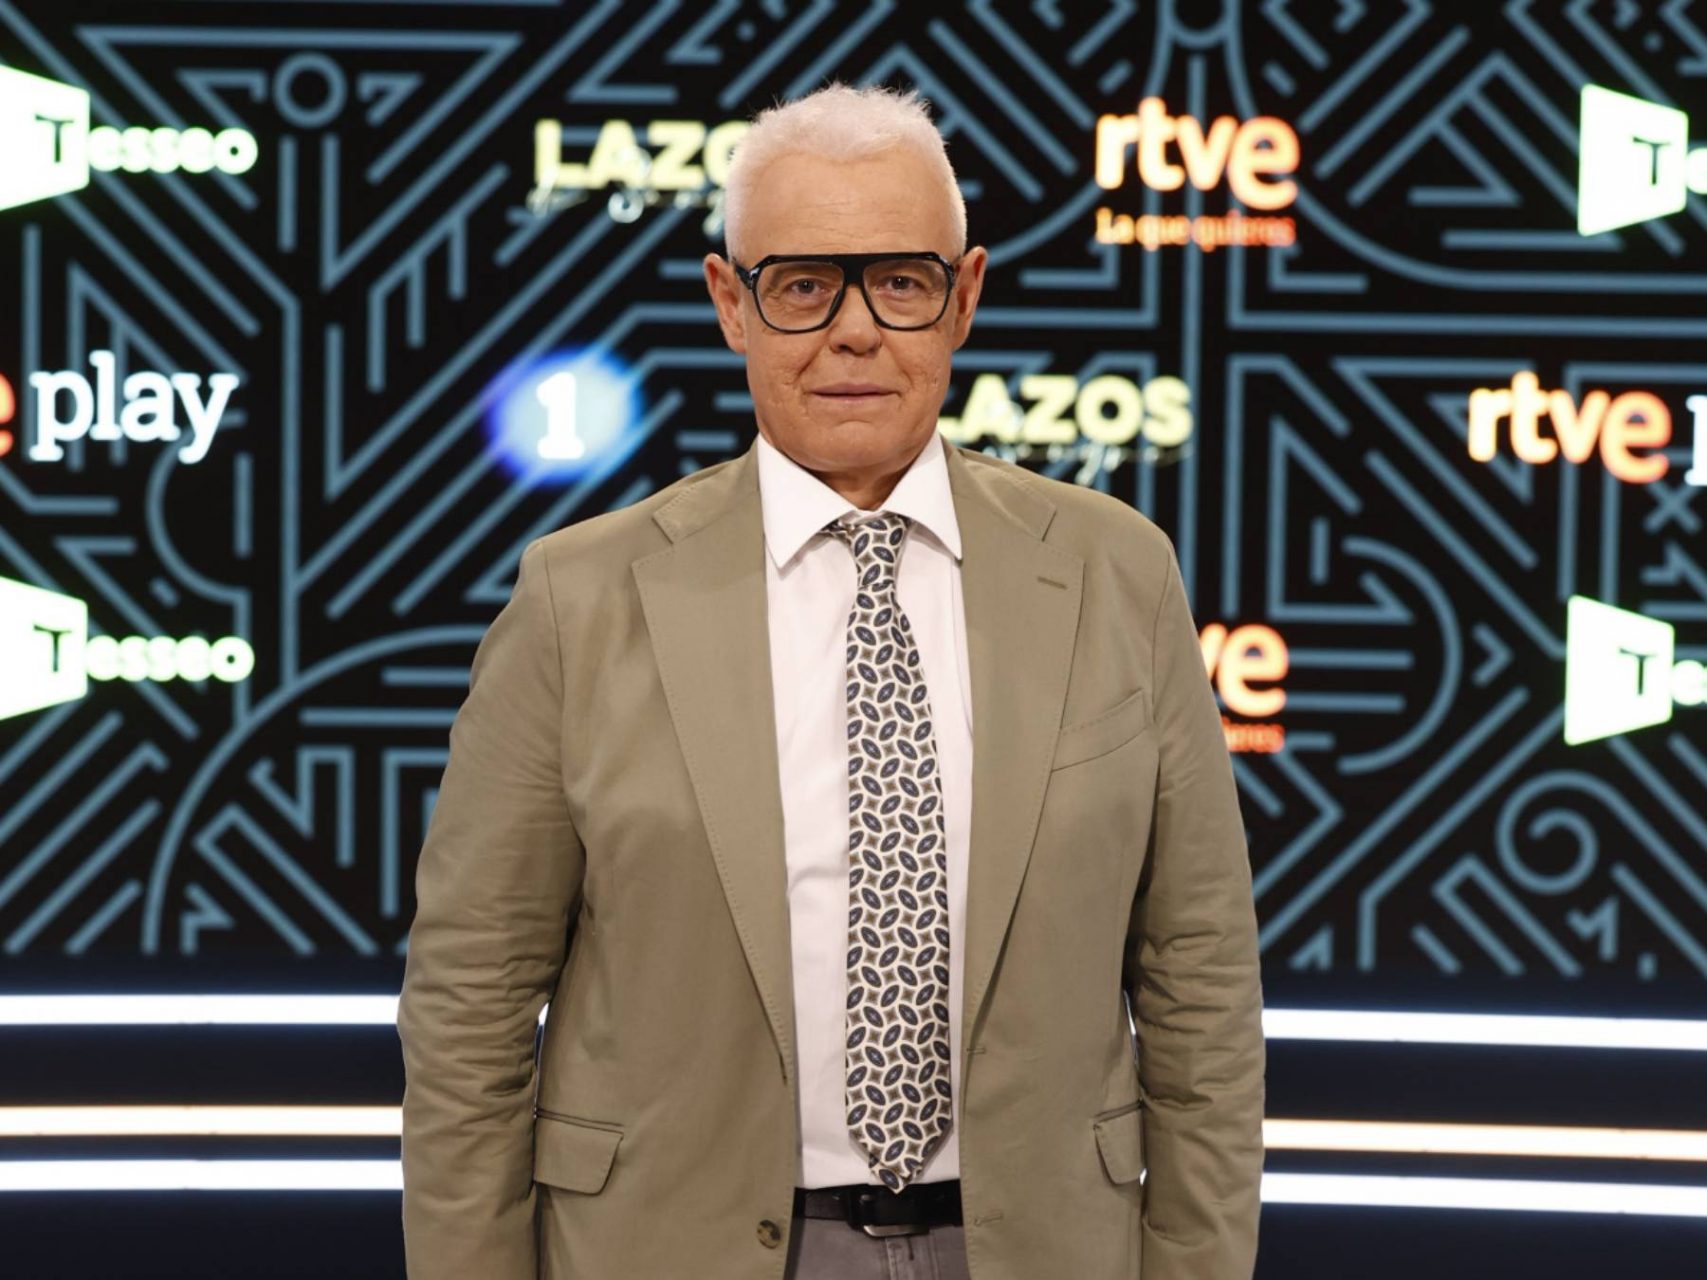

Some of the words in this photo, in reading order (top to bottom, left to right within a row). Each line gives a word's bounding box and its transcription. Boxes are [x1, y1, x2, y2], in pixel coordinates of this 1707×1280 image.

[34, 113, 259, 175] Tesseo
[1095, 96, 1300, 210] rtve
[28, 349, 240, 465] play
[537, 372, 585, 460] 1
[1467, 370, 1673, 484] rtve
[33, 623, 255, 682] Tesseo
